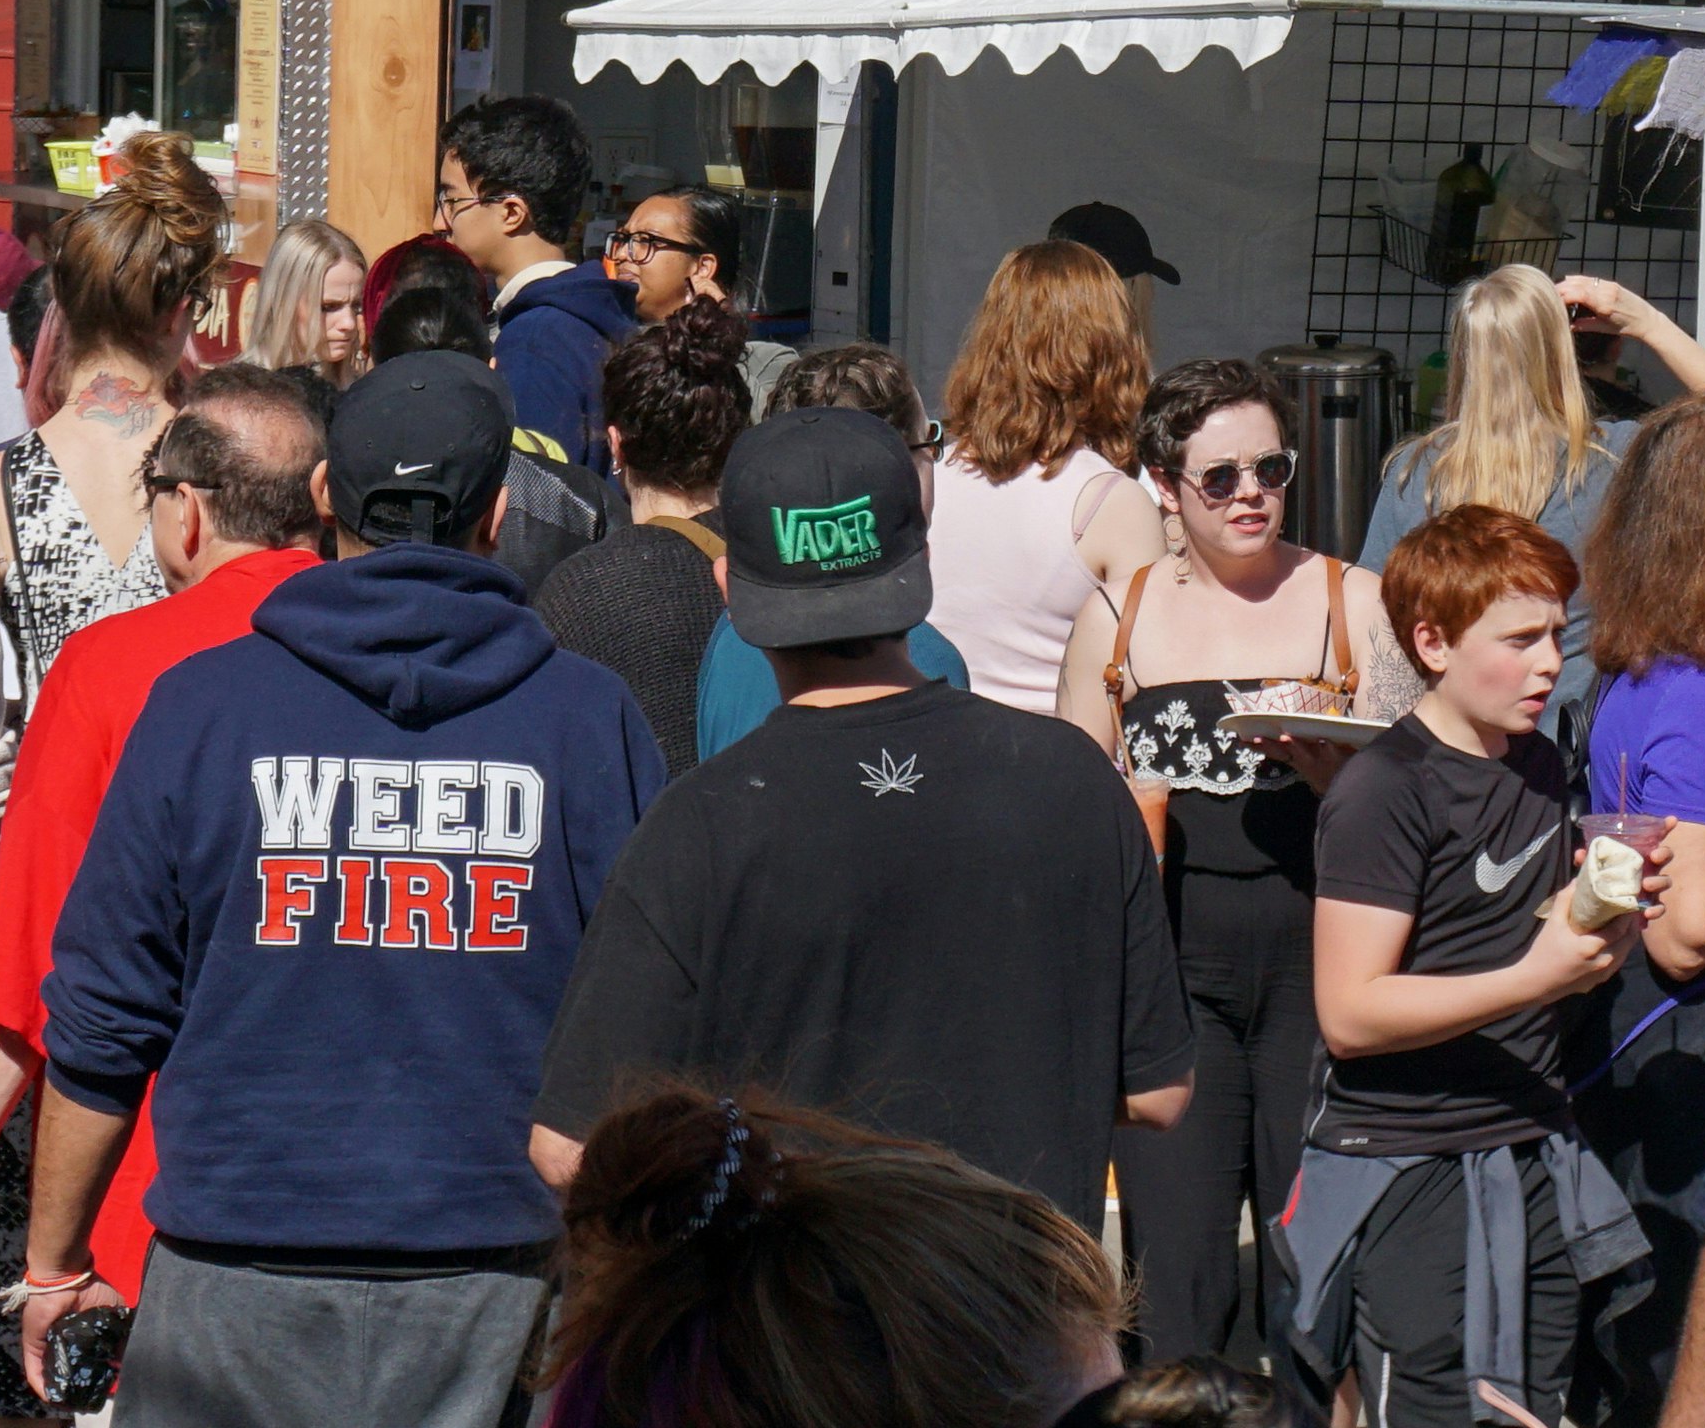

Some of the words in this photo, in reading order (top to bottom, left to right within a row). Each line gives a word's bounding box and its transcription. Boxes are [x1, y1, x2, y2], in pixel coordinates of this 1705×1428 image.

[769, 495, 881, 566] VADER
[820, 548, 882, 571] EXTRACTS
[251, 756, 545, 857] WEED
[255, 855, 534, 952] FIRE
